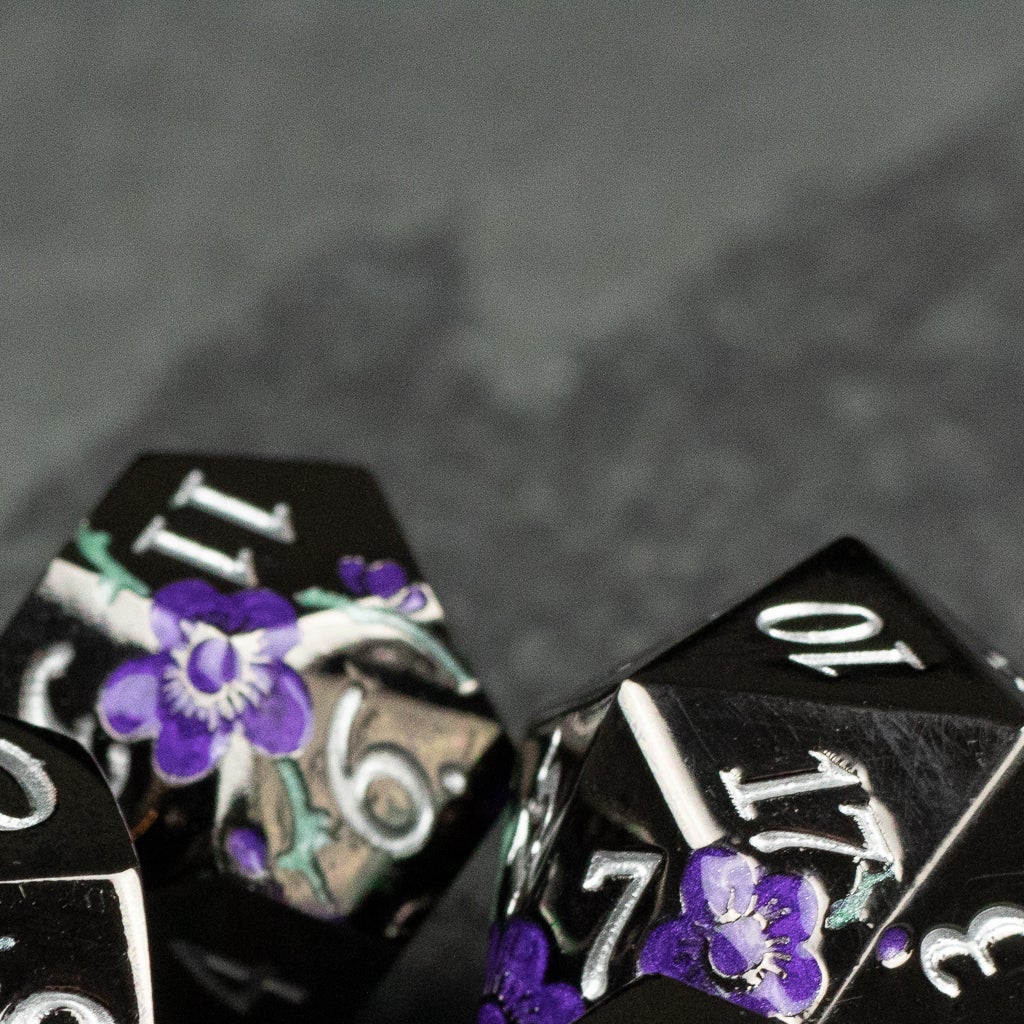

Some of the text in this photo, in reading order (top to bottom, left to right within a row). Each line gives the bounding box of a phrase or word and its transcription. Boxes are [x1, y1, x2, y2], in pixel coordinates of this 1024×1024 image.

[132, 469, 295, 588] 11
[755, 601, 925, 677] 10
[719, 750, 901, 863] 17
[581, 850, 663, 1001] 7
